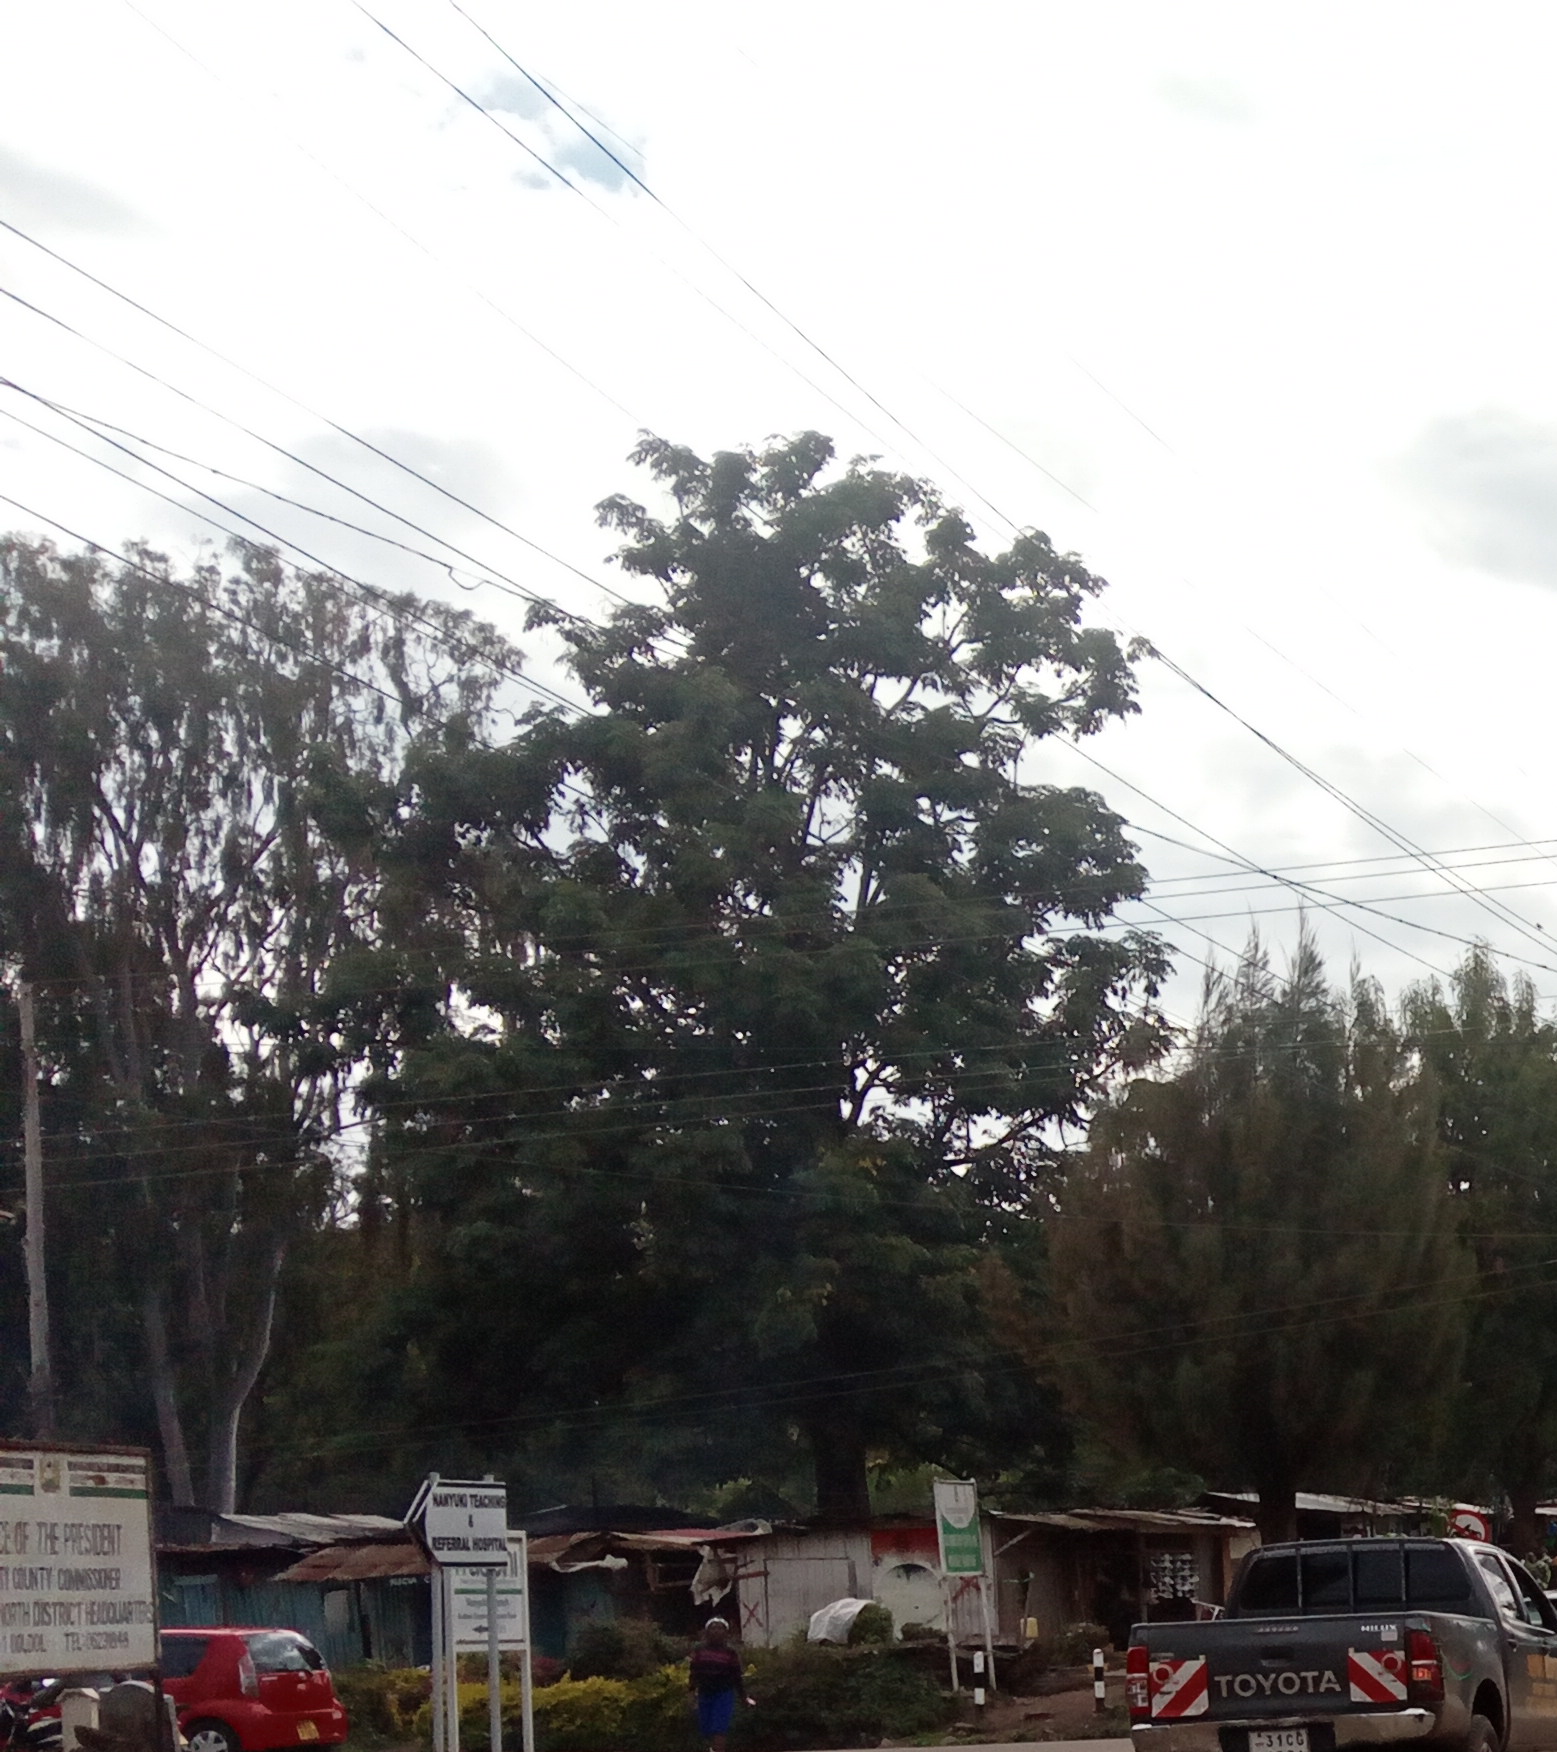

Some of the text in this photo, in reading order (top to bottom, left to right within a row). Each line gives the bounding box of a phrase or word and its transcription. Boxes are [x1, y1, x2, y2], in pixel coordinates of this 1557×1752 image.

[432, 1494, 506, 1508] NANYUKI TEACHING
[14, 1521, 30, 1555] OF
[36, 1522, 59, 1555] THE
[63, 1522, 122, 1555] PRESIDENT
[432, 1536, 507, 1551] REFERRAL HOSPITAL
[13, 1566, 121, 1591] COUNTY COMMISSIONER
[33, 1601, 84, 1626] DISTRICT
[1214, 1669, 1342, 1698] TOYOTA
